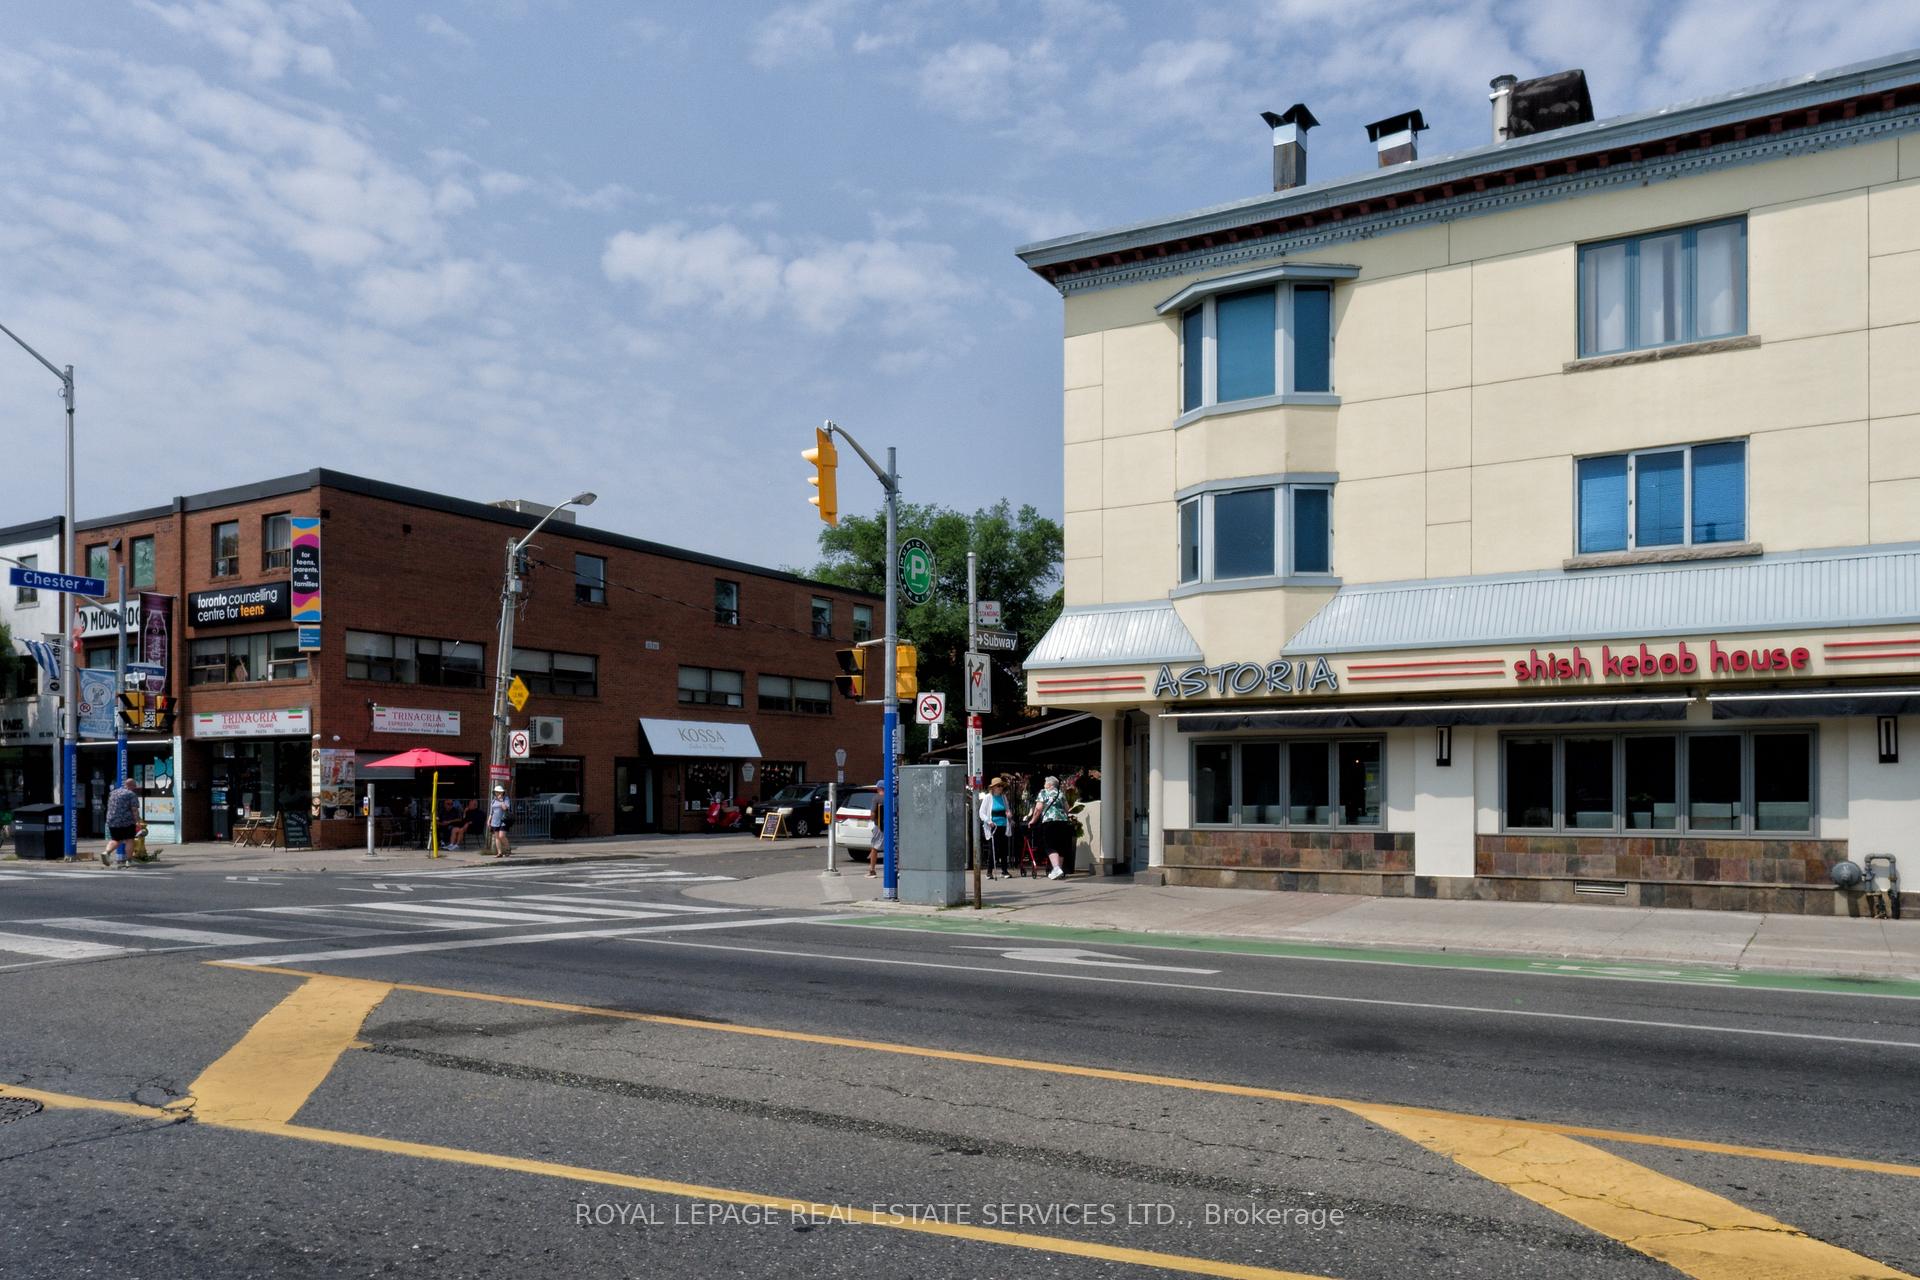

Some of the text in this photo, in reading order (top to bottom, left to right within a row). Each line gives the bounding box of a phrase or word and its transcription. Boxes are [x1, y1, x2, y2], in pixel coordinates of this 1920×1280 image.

[911, 554, 926, 581] P
[23, 571, 95, 590] Chester Av
[294, 580, 319, 588] families
[303, 573, 310, 581] &
[197, 588, 278, 609] toronto counselling
[197, 604, 265, 622] centre for teens
[983, 633, 1017, 650] Subway
[1513, 639, 1810, 681] shish kebob house
[1152, 655, 1338, 697] ASTORIA
[222, 711, 278, 724] TRINACRIA
[391, 711, 442, 722] TRINACRIA
[678, 727, 727, 744] KOSSA
[891, 728, 899, 793] GREEKTOWN
